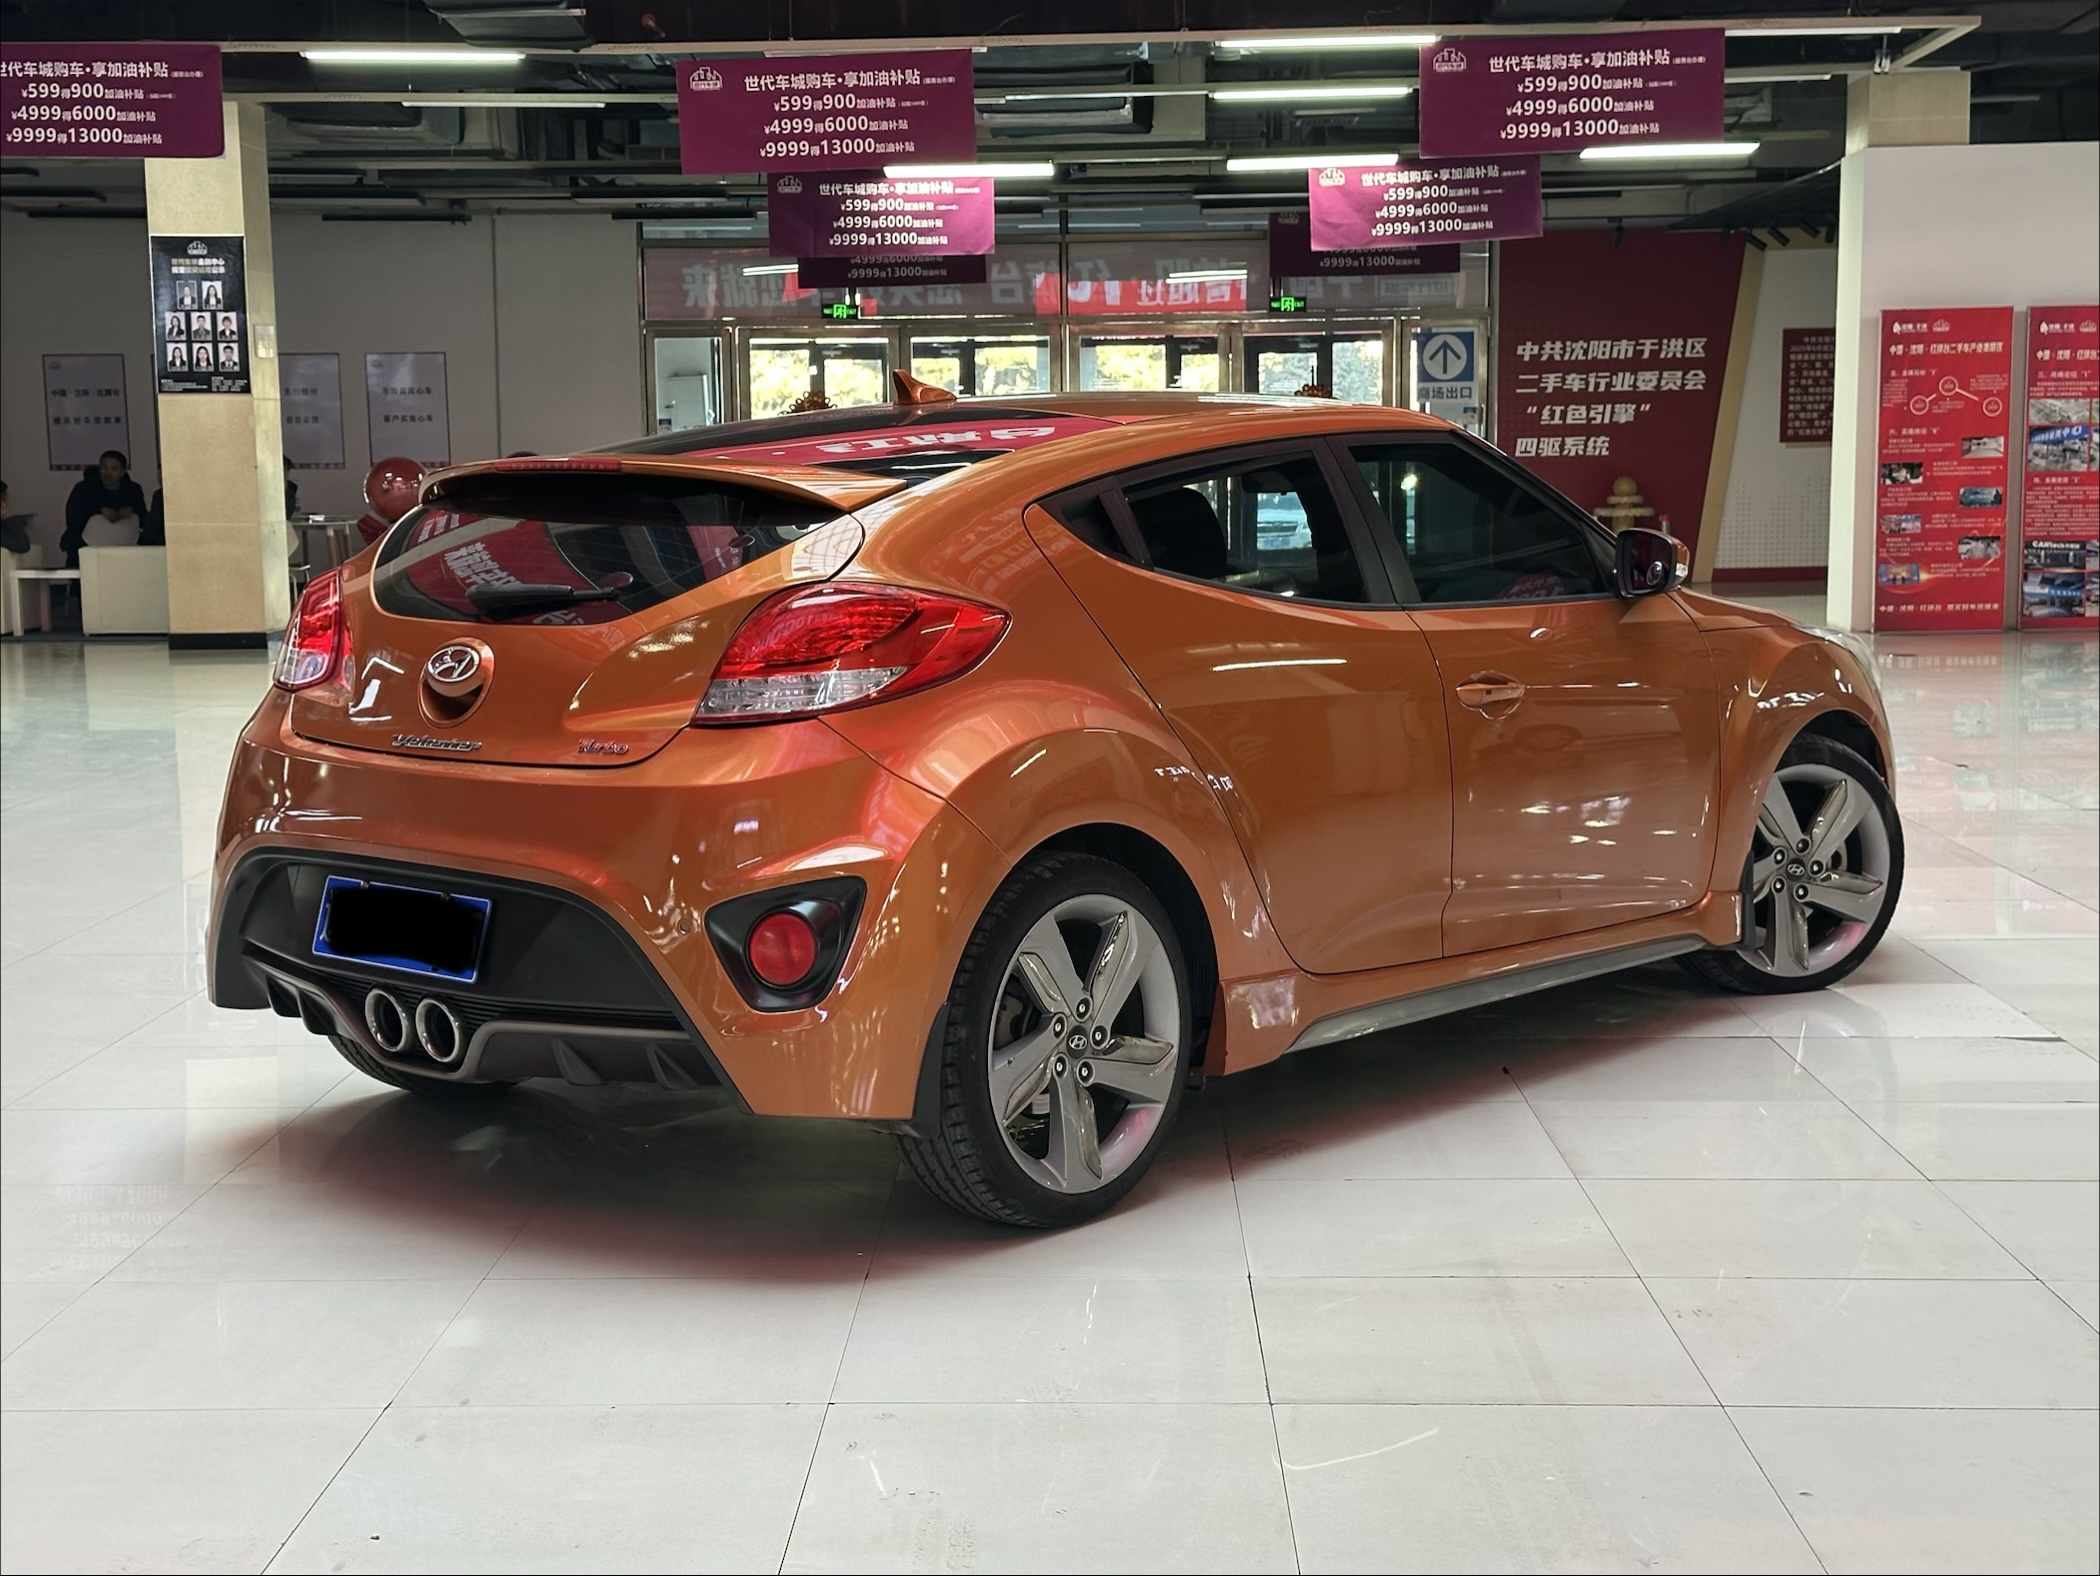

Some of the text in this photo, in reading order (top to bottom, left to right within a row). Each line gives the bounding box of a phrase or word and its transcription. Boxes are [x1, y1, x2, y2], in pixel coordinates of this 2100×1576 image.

[1489, 48, 1671, 73] 世代车城购车·享加油补贴
[21, 83, 145, 99] ¥599得900加油补贴
[744, 68, 921, 93] 世代车城购车·享加油补贴
[1517, 74, 1644, 93] ¥599得900加油补贴
[11, 105, 157, 122] ¥4999得6000加油补贴
[773, 93, 896, 113] ¥599得900加油补贴
[1506, 96, 1655, 117] ¥4999得6000加油补贴
[6, 127, 163, 144] ¥9999得13000加油补贴
[763, 115, 909, 135] ¥4999得6000加油补贴
[1500, 119, 1660, 140] ¥9999得13000加油补贴
[759, 137, 915, 158] ¥9999得13000加油补贴
[1361, 165, 1499, 187] 世代车城购车·享加油补贴
[819, 181, 954, 196] 世代车城购车·享加油补贴
[1516, 338, 1708, 361] 中共沈阳市于洪区
[1515, 370, 1707, 393] 二手车行业委员会
[1418, 386, 1472, 400] 商场出口
[1526, 403, 1651, 425] “红色引擎”
[1515, 436, 1610, 457] 四驱系统
[577, 738, 630, 754] Turbo
